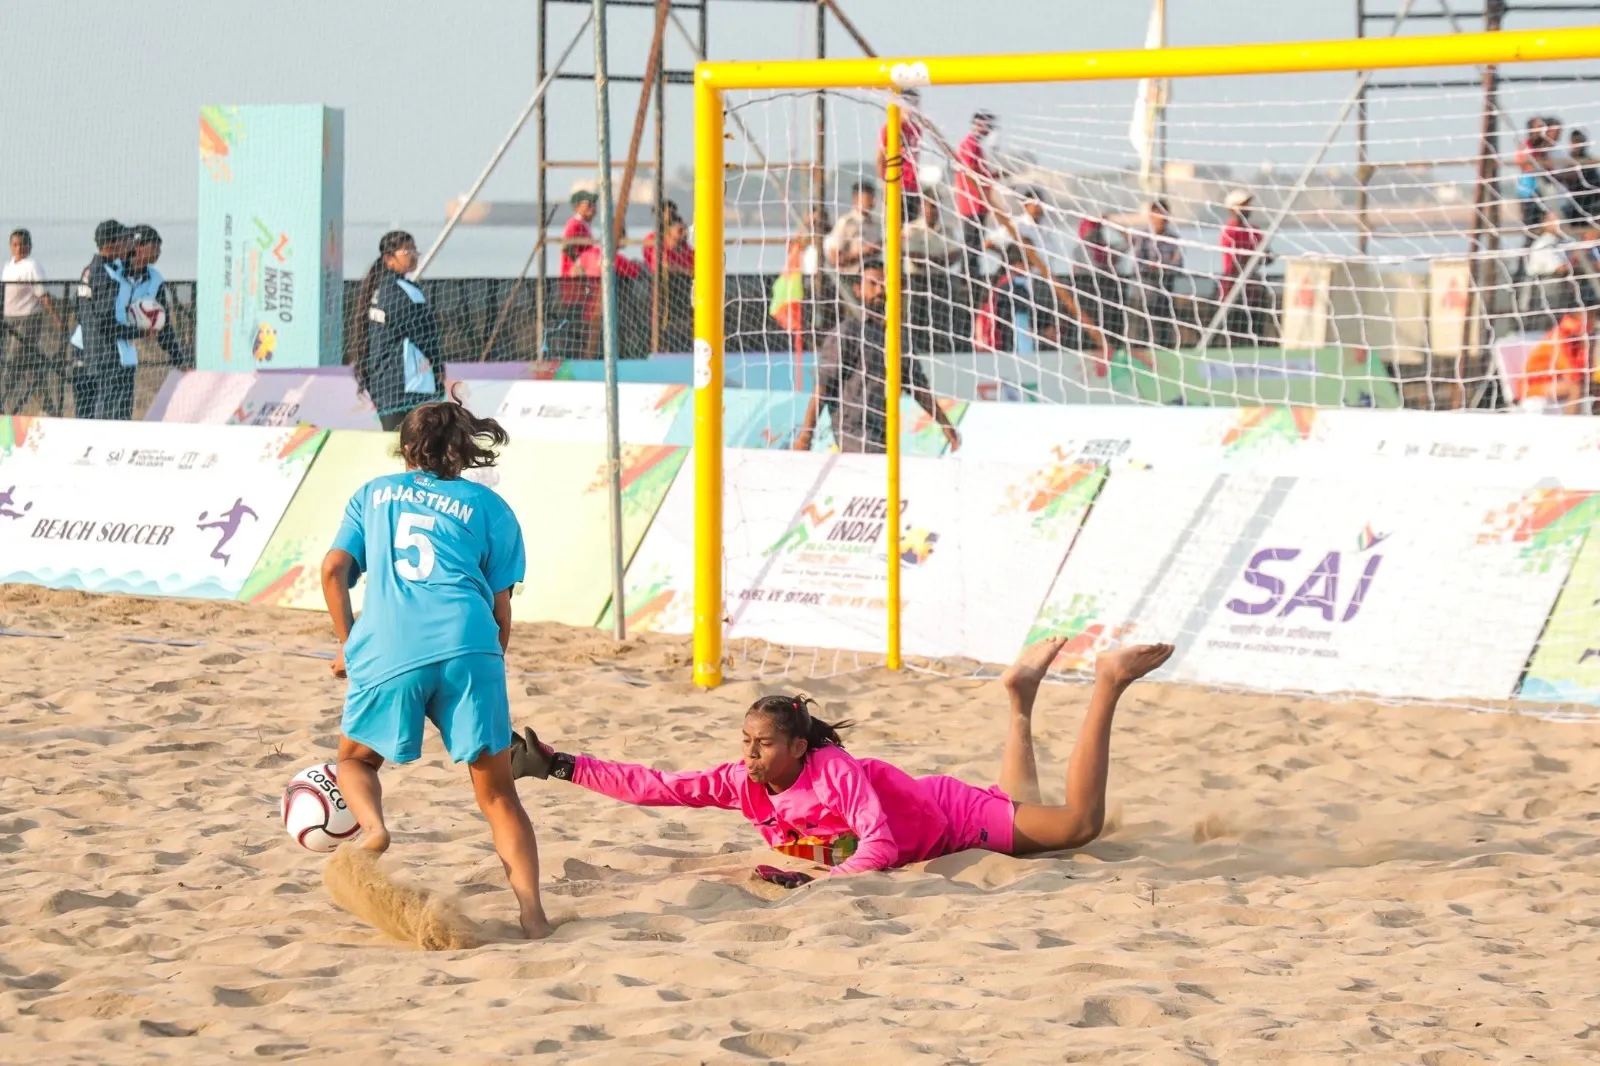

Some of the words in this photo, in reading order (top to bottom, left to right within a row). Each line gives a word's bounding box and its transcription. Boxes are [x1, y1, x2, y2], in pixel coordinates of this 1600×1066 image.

[264, 266, 278, 312] INDIA
[279, 269, 293, 323] KHELO
[372, 484, 474, 525] RAJASTHAN
[31, 518, 97, 541] BEACH
[96, 521, 175, 546] SOCCER
[393, 511, 436, 581] 5
[826, 520, 884, 544] INDIA
[1225, 547, 1384, 623] SAI
[306, 769, 347, 811] COSCO
